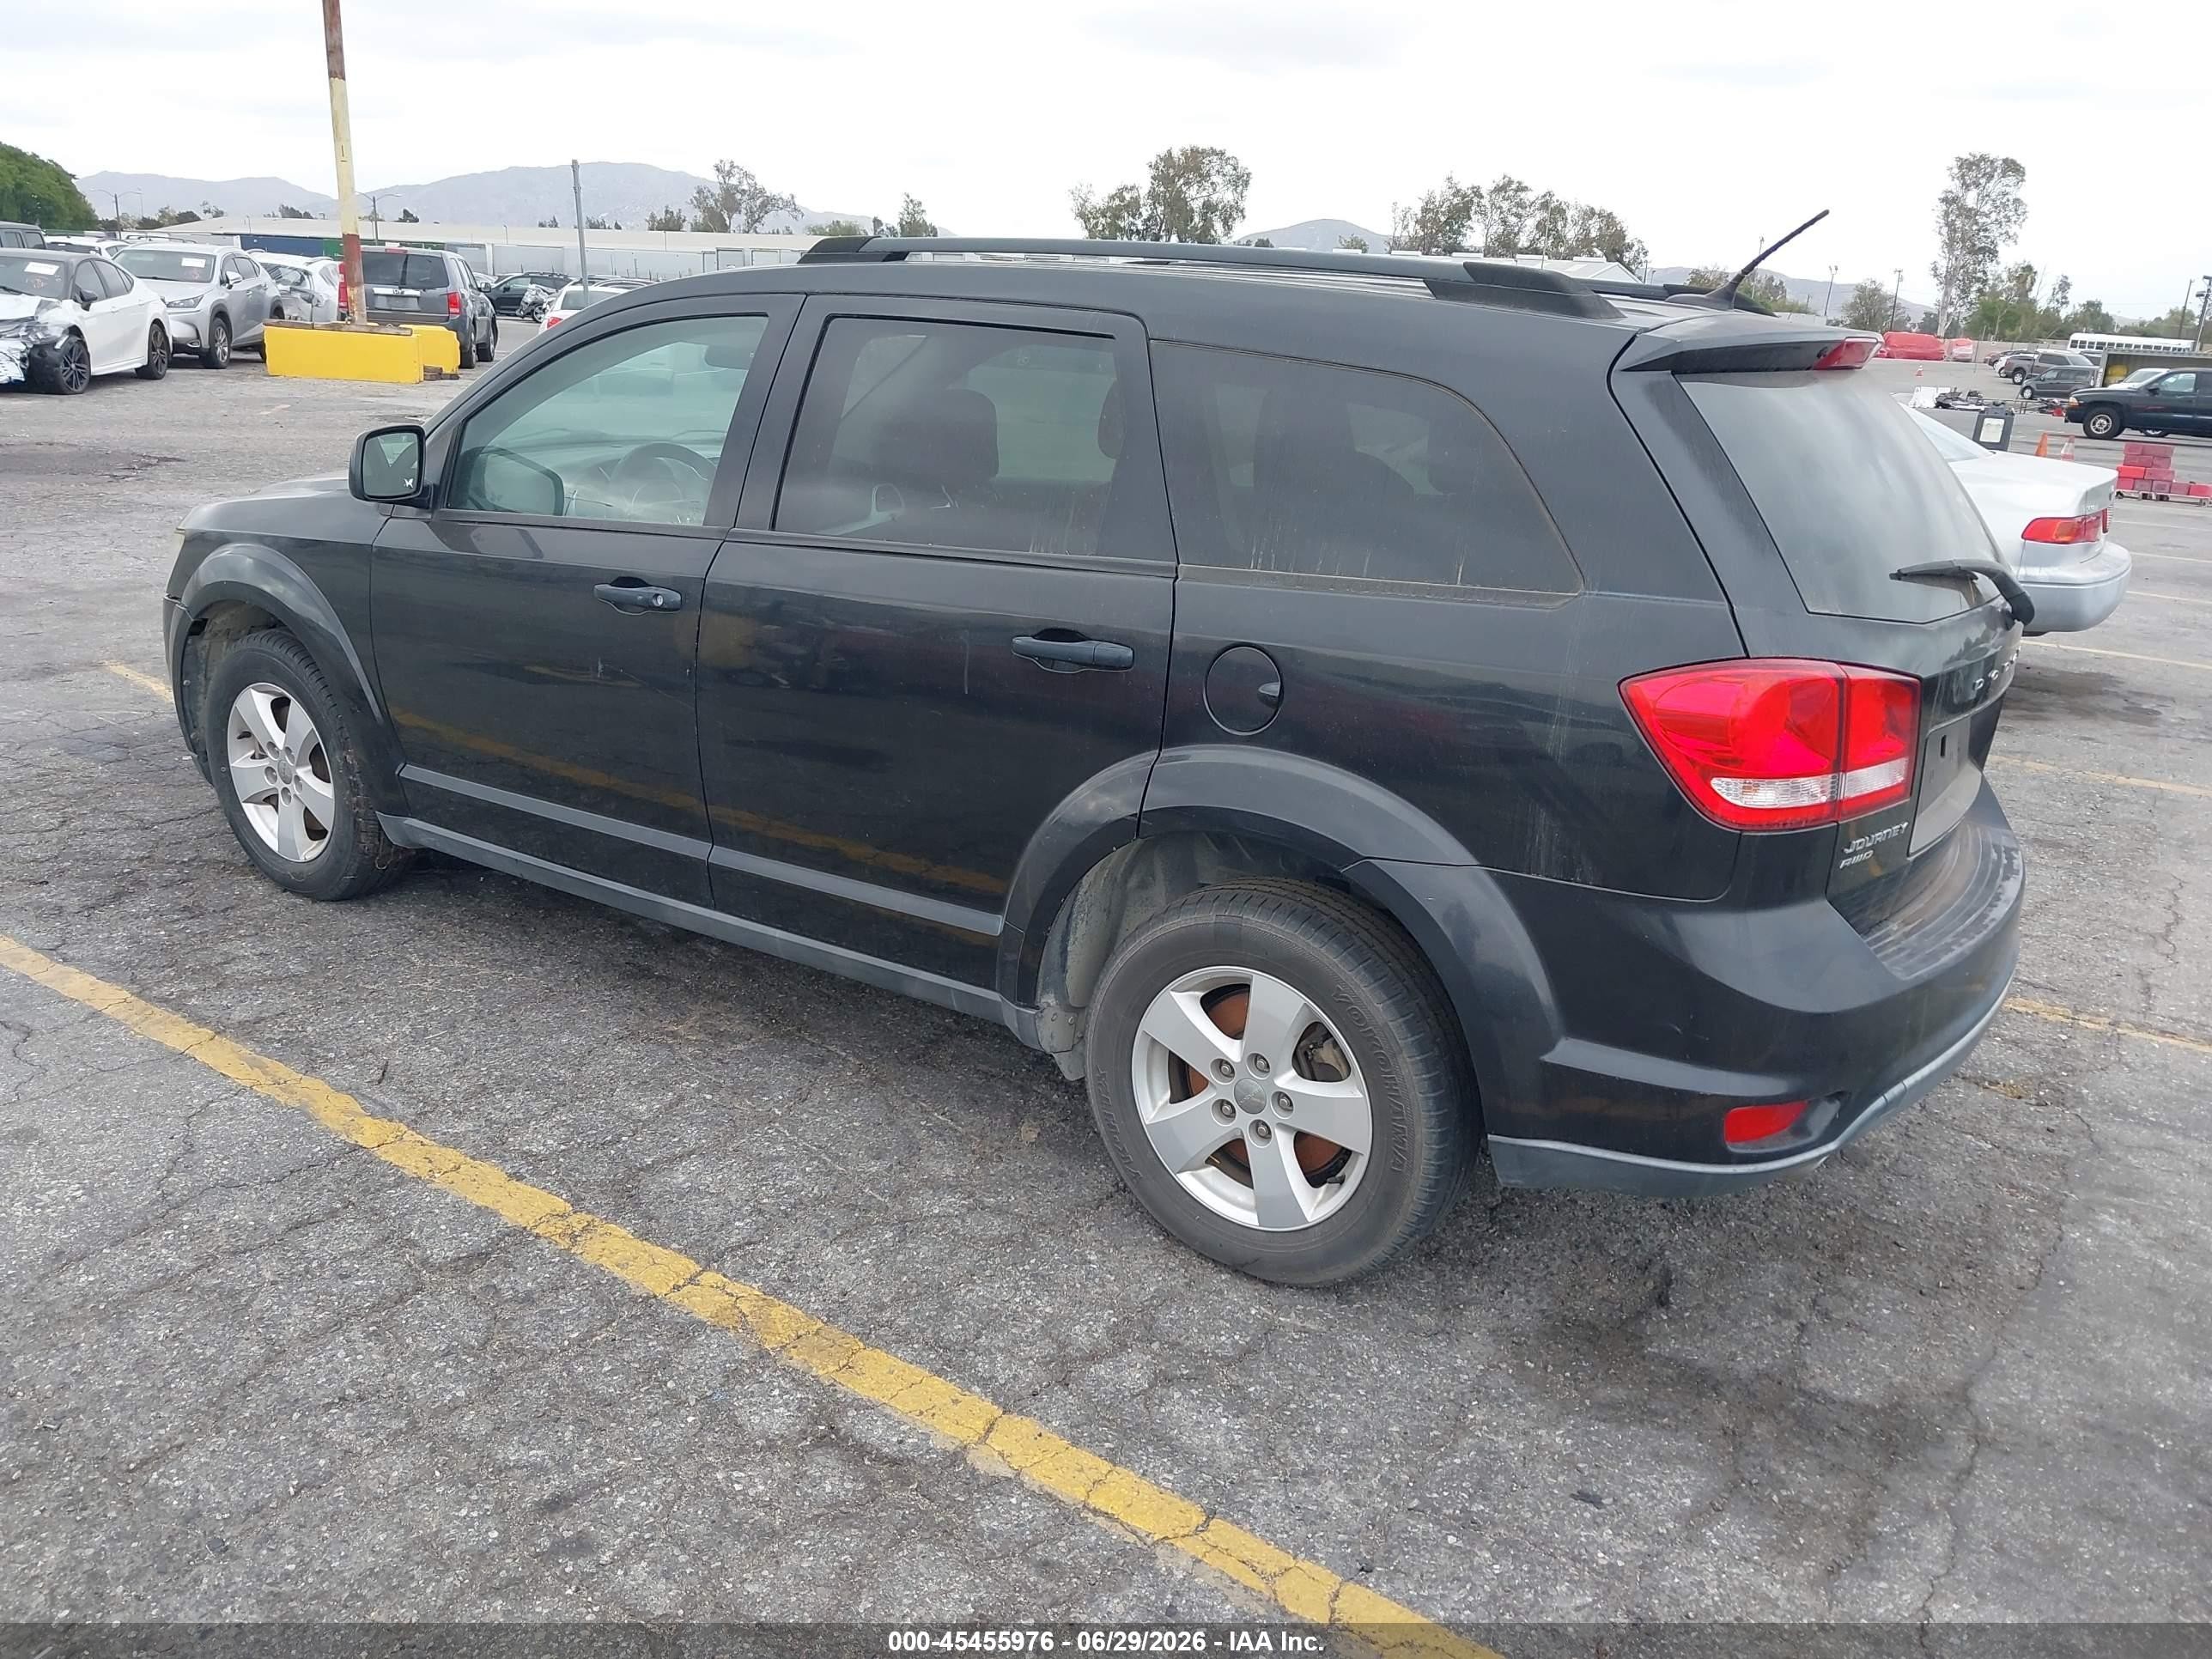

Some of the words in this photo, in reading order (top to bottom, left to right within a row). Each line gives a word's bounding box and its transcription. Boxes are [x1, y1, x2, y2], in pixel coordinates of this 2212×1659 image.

[1842, 821, 1909, 854] JOURNEY
[1838, 849, 1875, 870] AWD
[1331, 984, 1409, 1174] YOKOHAMA
